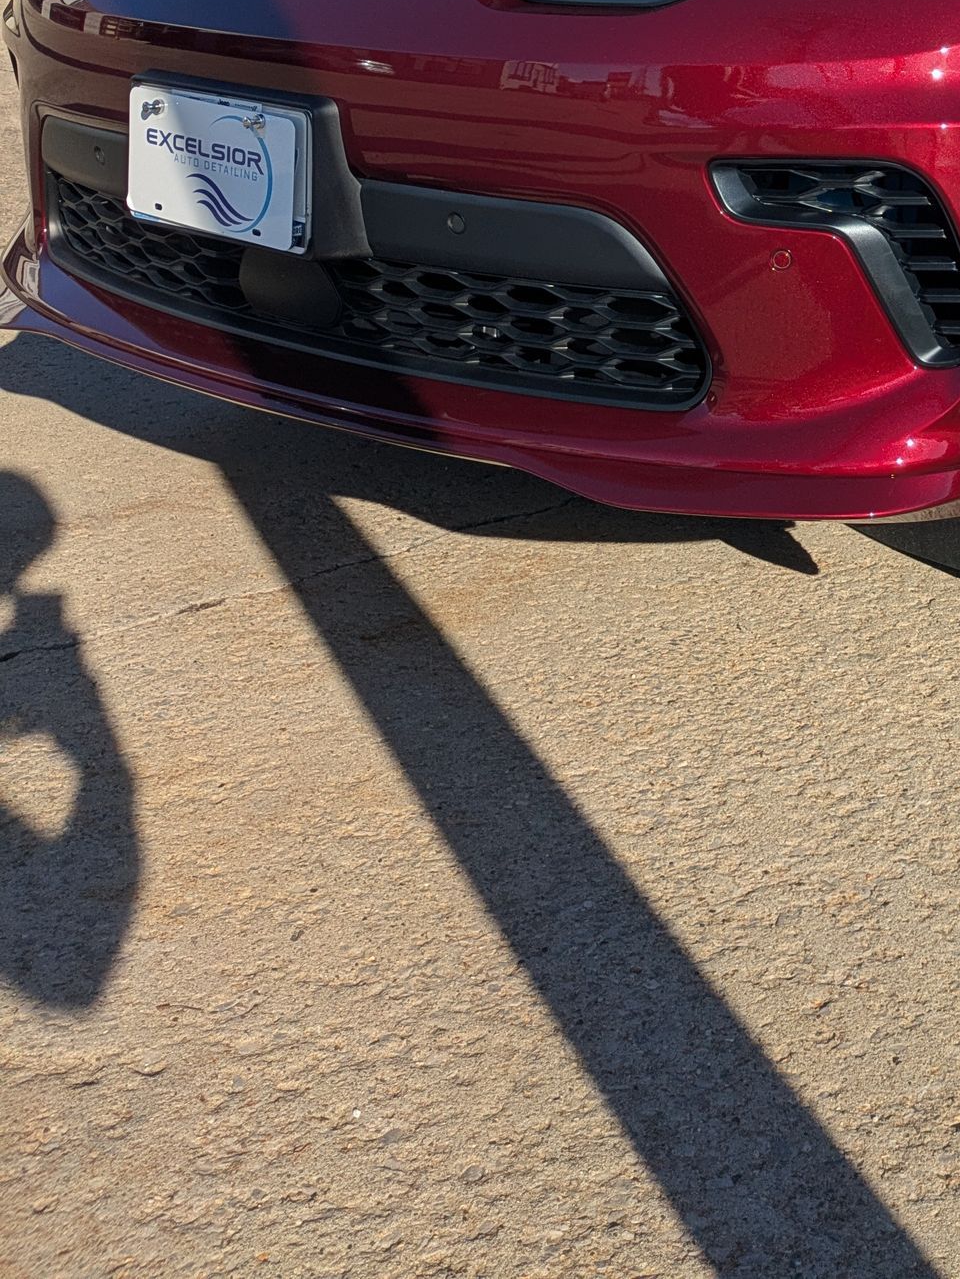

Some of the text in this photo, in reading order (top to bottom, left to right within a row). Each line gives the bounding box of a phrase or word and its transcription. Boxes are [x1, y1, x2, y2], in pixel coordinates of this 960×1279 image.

[146, 127, 264, 175] EXCELSIOR
[174, 154, 258, 182] AUTO DETAILING
